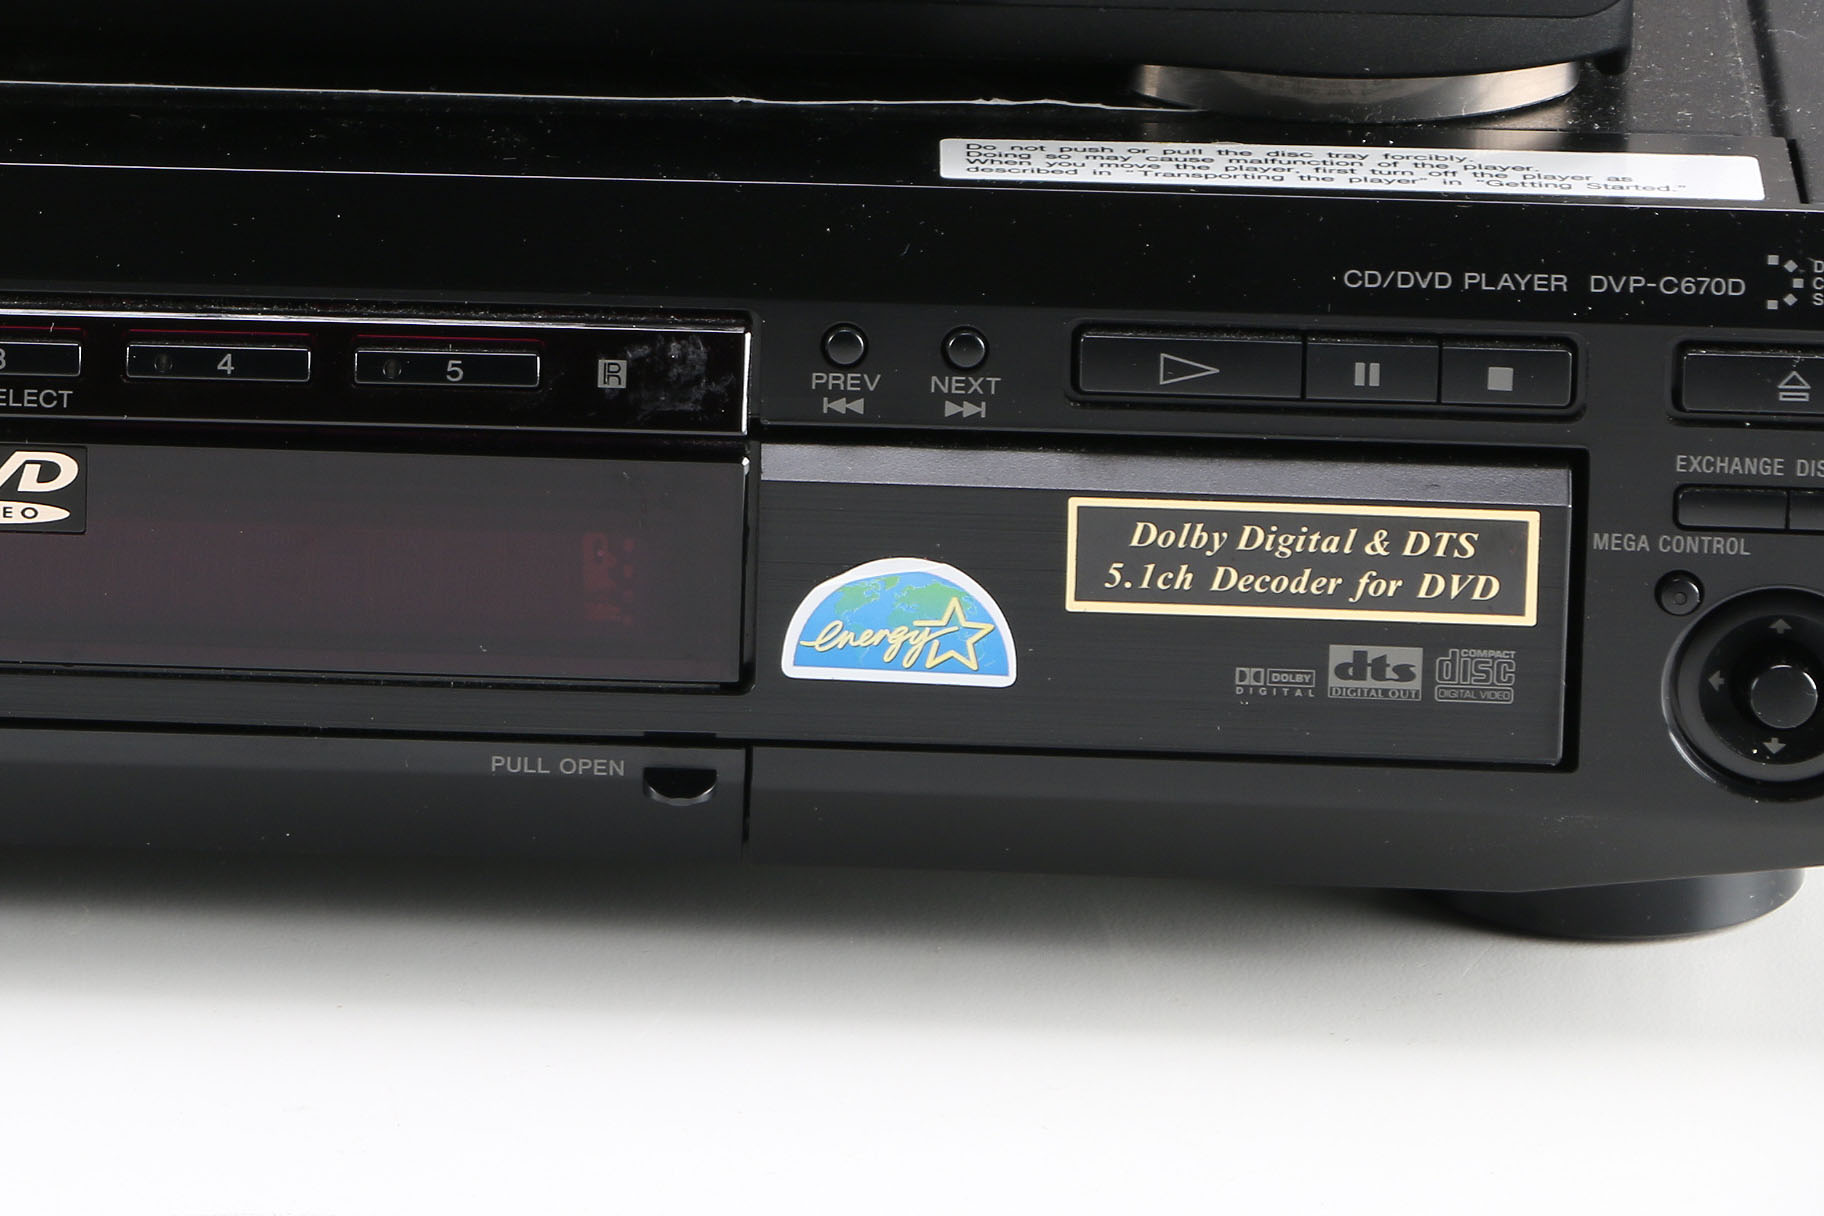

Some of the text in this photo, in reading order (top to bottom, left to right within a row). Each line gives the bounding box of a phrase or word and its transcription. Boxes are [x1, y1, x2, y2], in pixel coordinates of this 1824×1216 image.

[1343, 270, 1746, 297] CD/DVD PLAYER DVP-C670D
[215, 352, 235, 376] 4
[444, 359, 463, 383] 5
[811, 373, 881, 392] PREV
[930, 376, 1001, 395] NEXT
[1676, 455, 1785, 476] EXCHANGE
[1131, 521, 1479, 559] Dolby Digital & DTS
[1592, 533, 1751, 556] MEGA CONTROL
[1104, 563, 1501, 603] 5.1ch Decoder for DVD
[802, 620, 941, 668] energy
[1460, 649, 1516, 658] COMPACT
[1333, 650, 1417, 683] dts
[1271, 673, 1312, 683] DOLBY
[1234, 686, 1315, 698] DIGITAL
[1332, 688, 1417, 699] DIGITAL OUT
[1438, 688, 1511, 700] DIGITAL VIDEO
[491, 755, 625, 777] PULL OPEN
